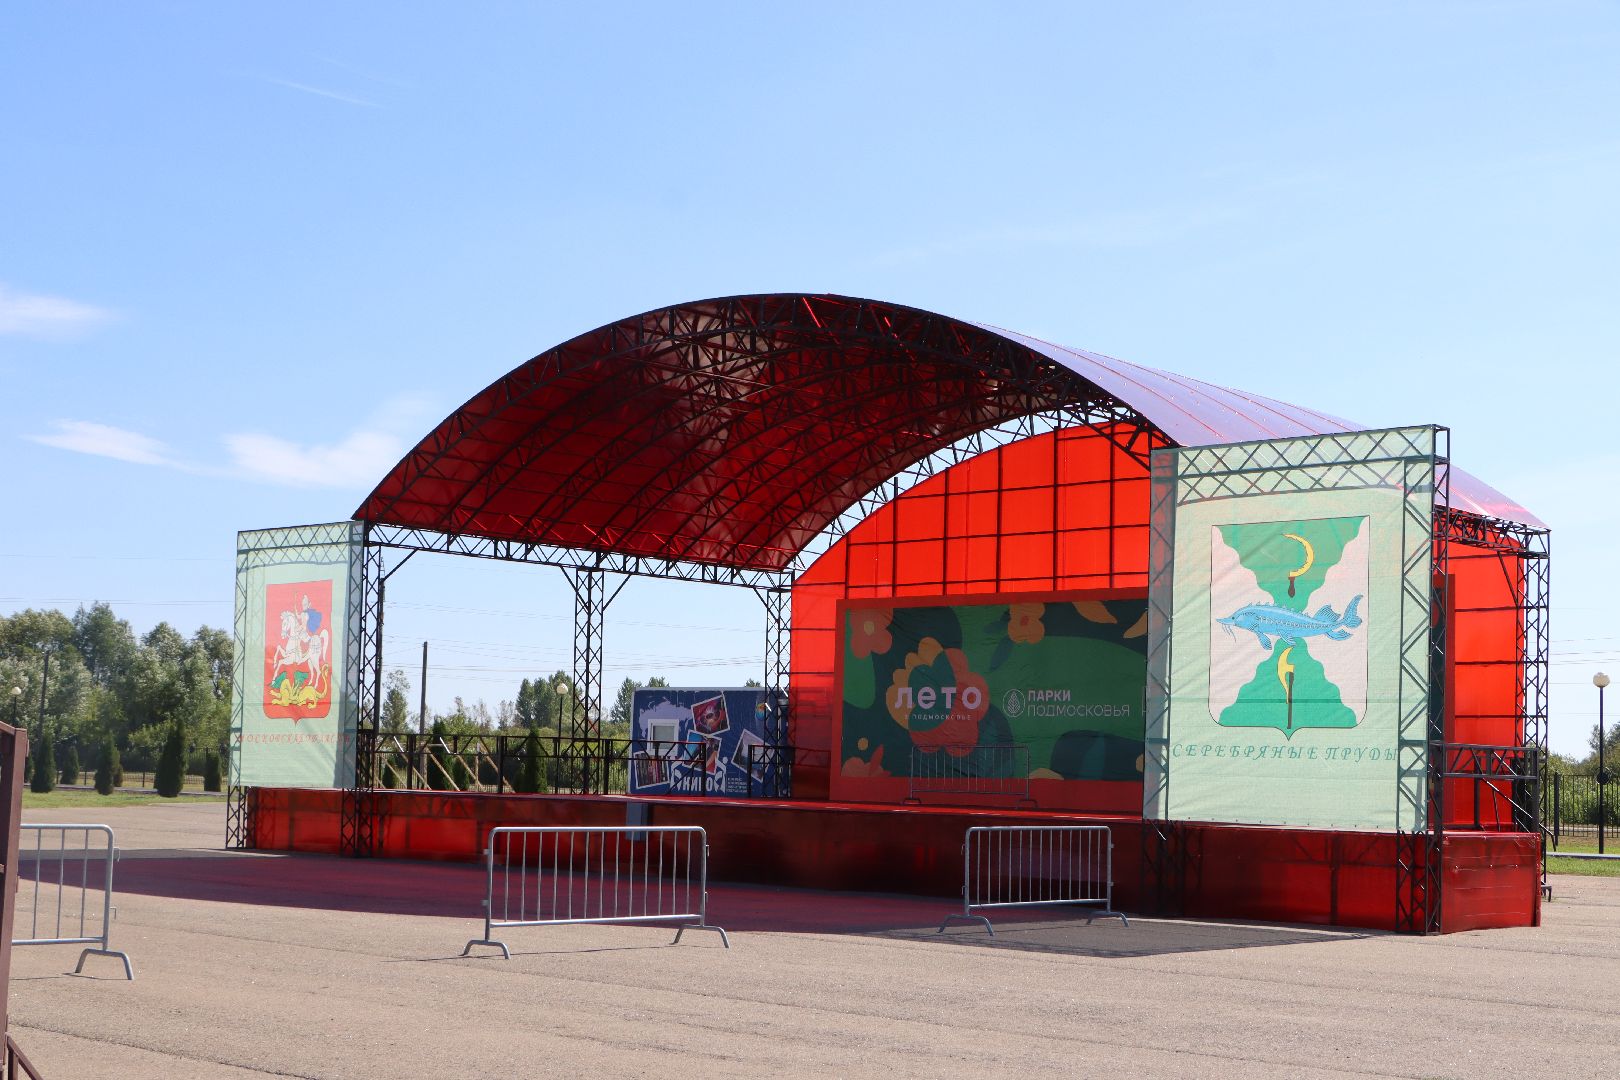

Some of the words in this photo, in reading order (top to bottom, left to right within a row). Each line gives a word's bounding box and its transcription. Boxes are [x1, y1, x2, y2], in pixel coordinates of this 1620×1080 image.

[1027, 690, 1071, 702] ПАРКИ
[1027, 704, 1131, 717] ПОДМОСКОВЬЯ
[1172, 743, 1318, 761] СЕРЕБРЯНЫЕ
[1325, 746, 1398, 763] ПРУДЫ
